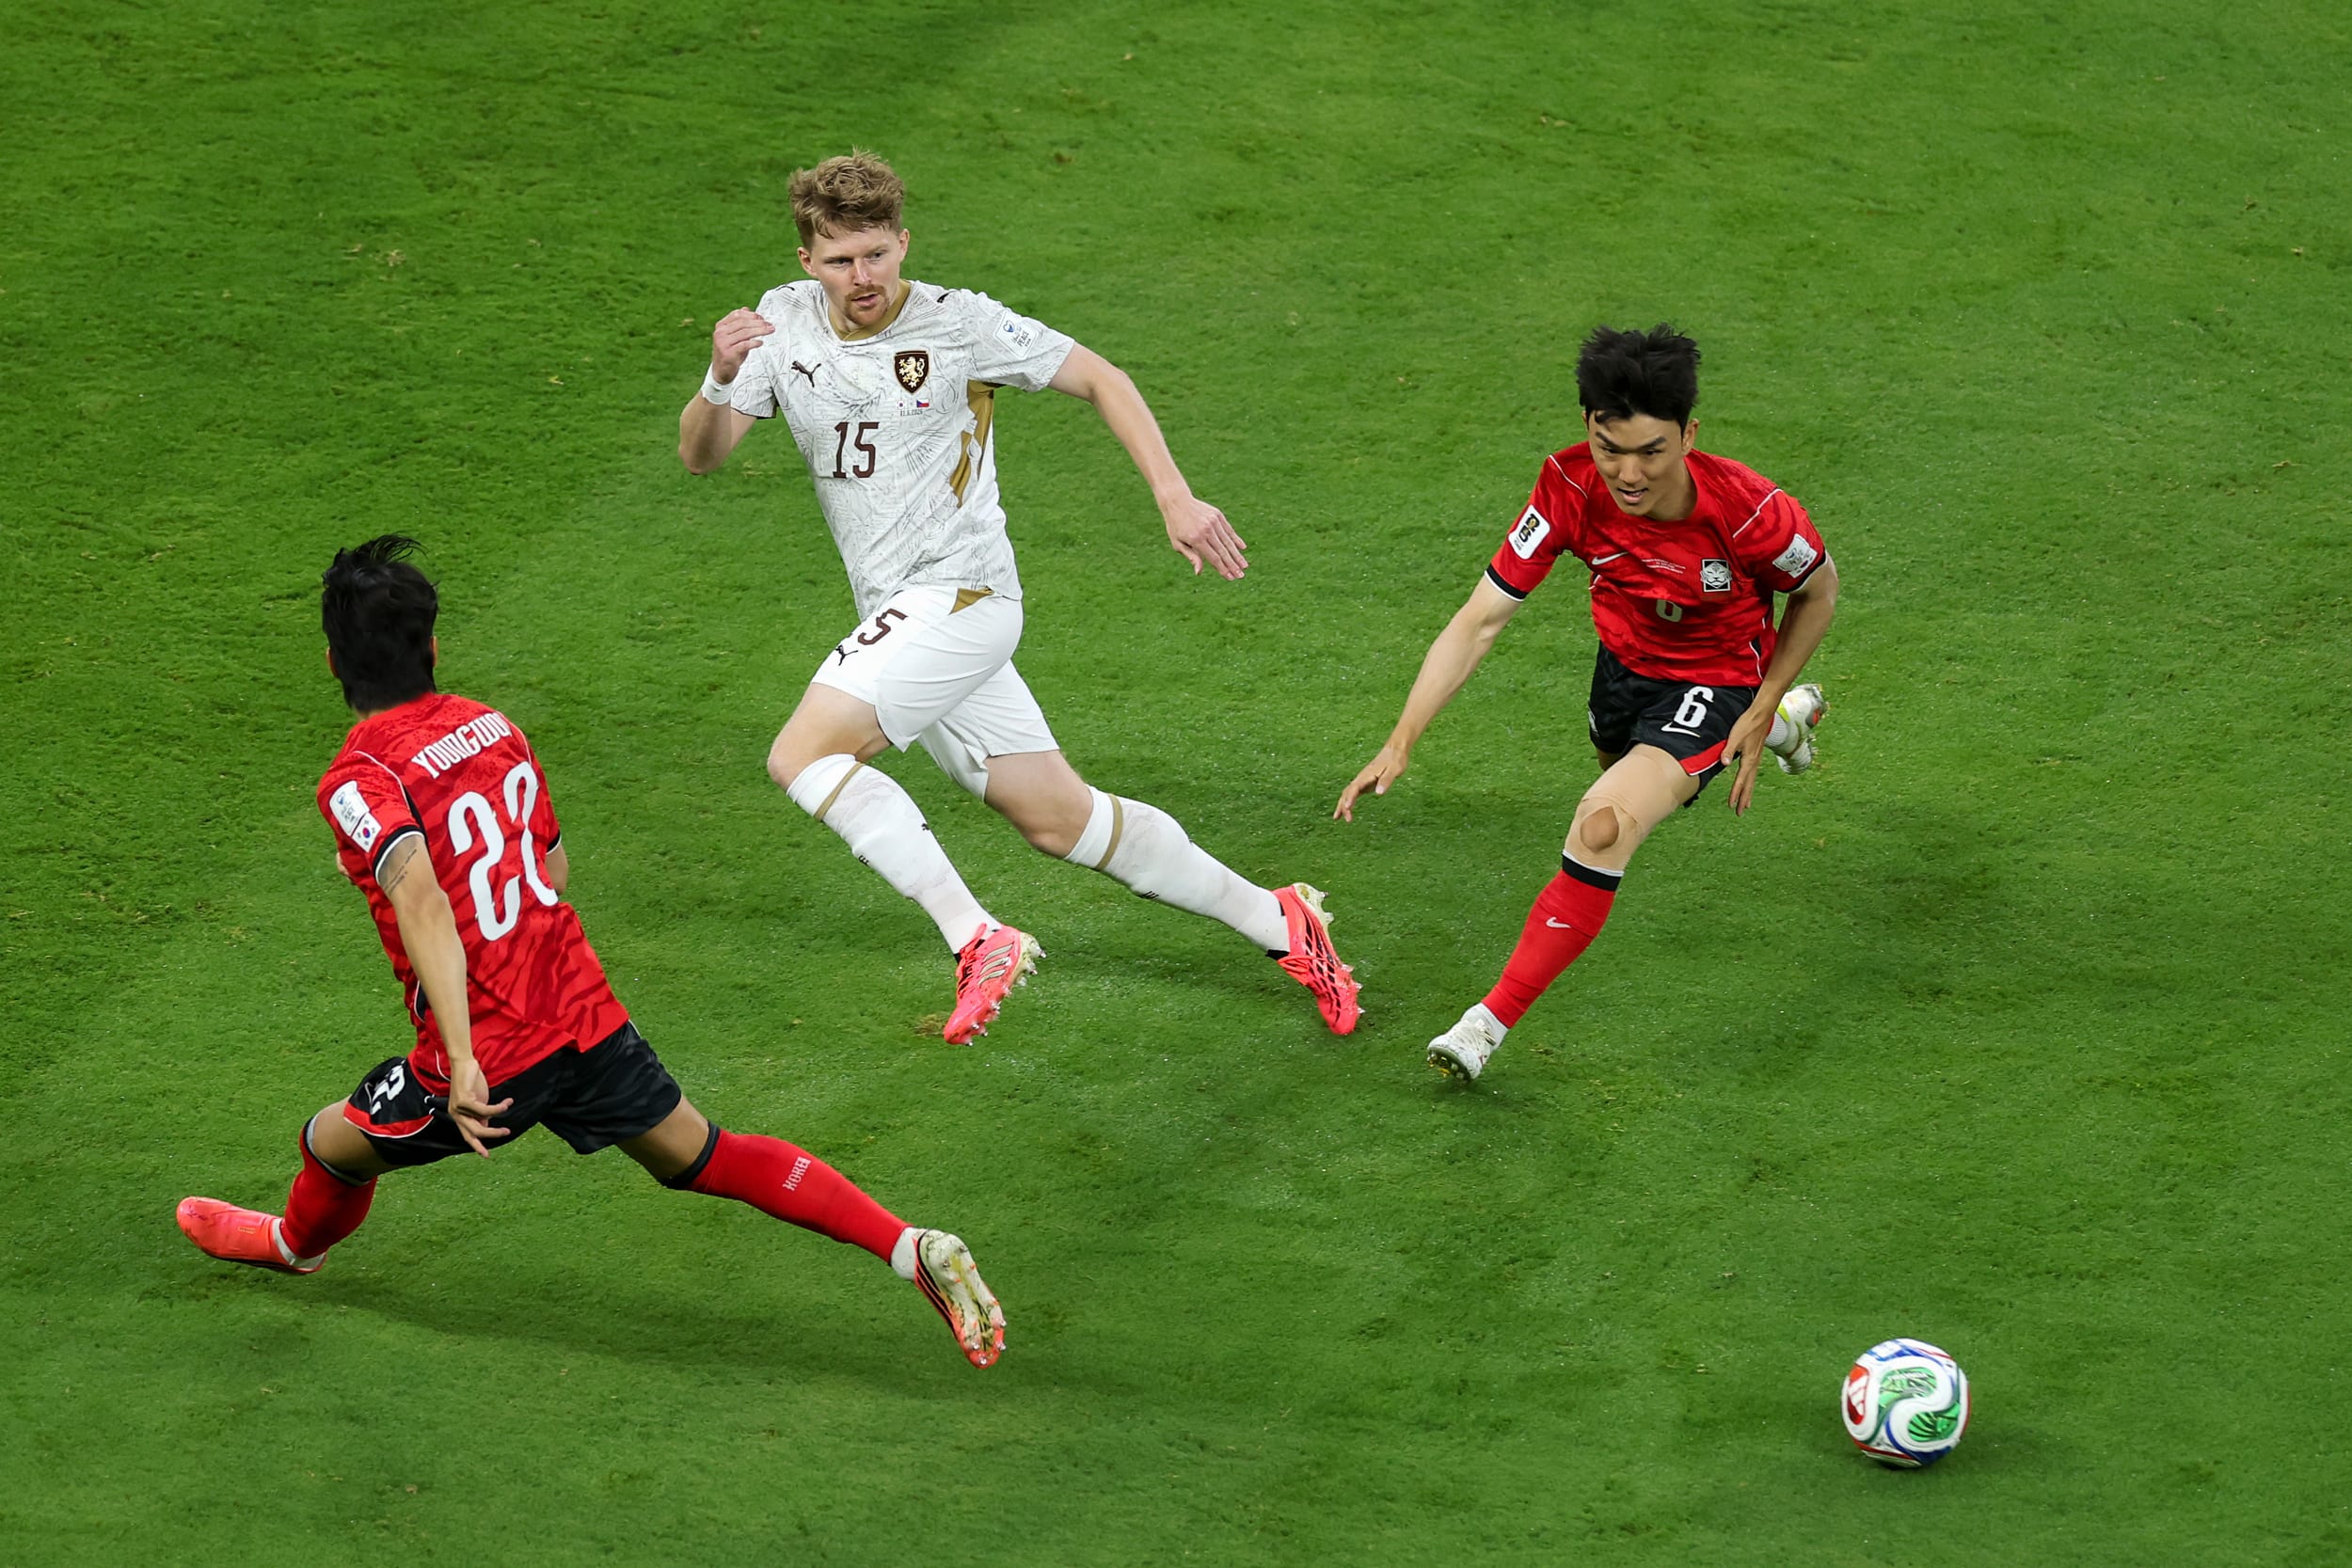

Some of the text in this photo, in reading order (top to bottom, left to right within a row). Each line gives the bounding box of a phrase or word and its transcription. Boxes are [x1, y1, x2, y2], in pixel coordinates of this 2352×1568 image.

[832, 421, 881, 479] 15
[851, 608, 909, 646] 5
[1673, 686, 1714, 728] 6
[447, 761, 559, 941] 22
[370, 1060, 405, 1116] 2
